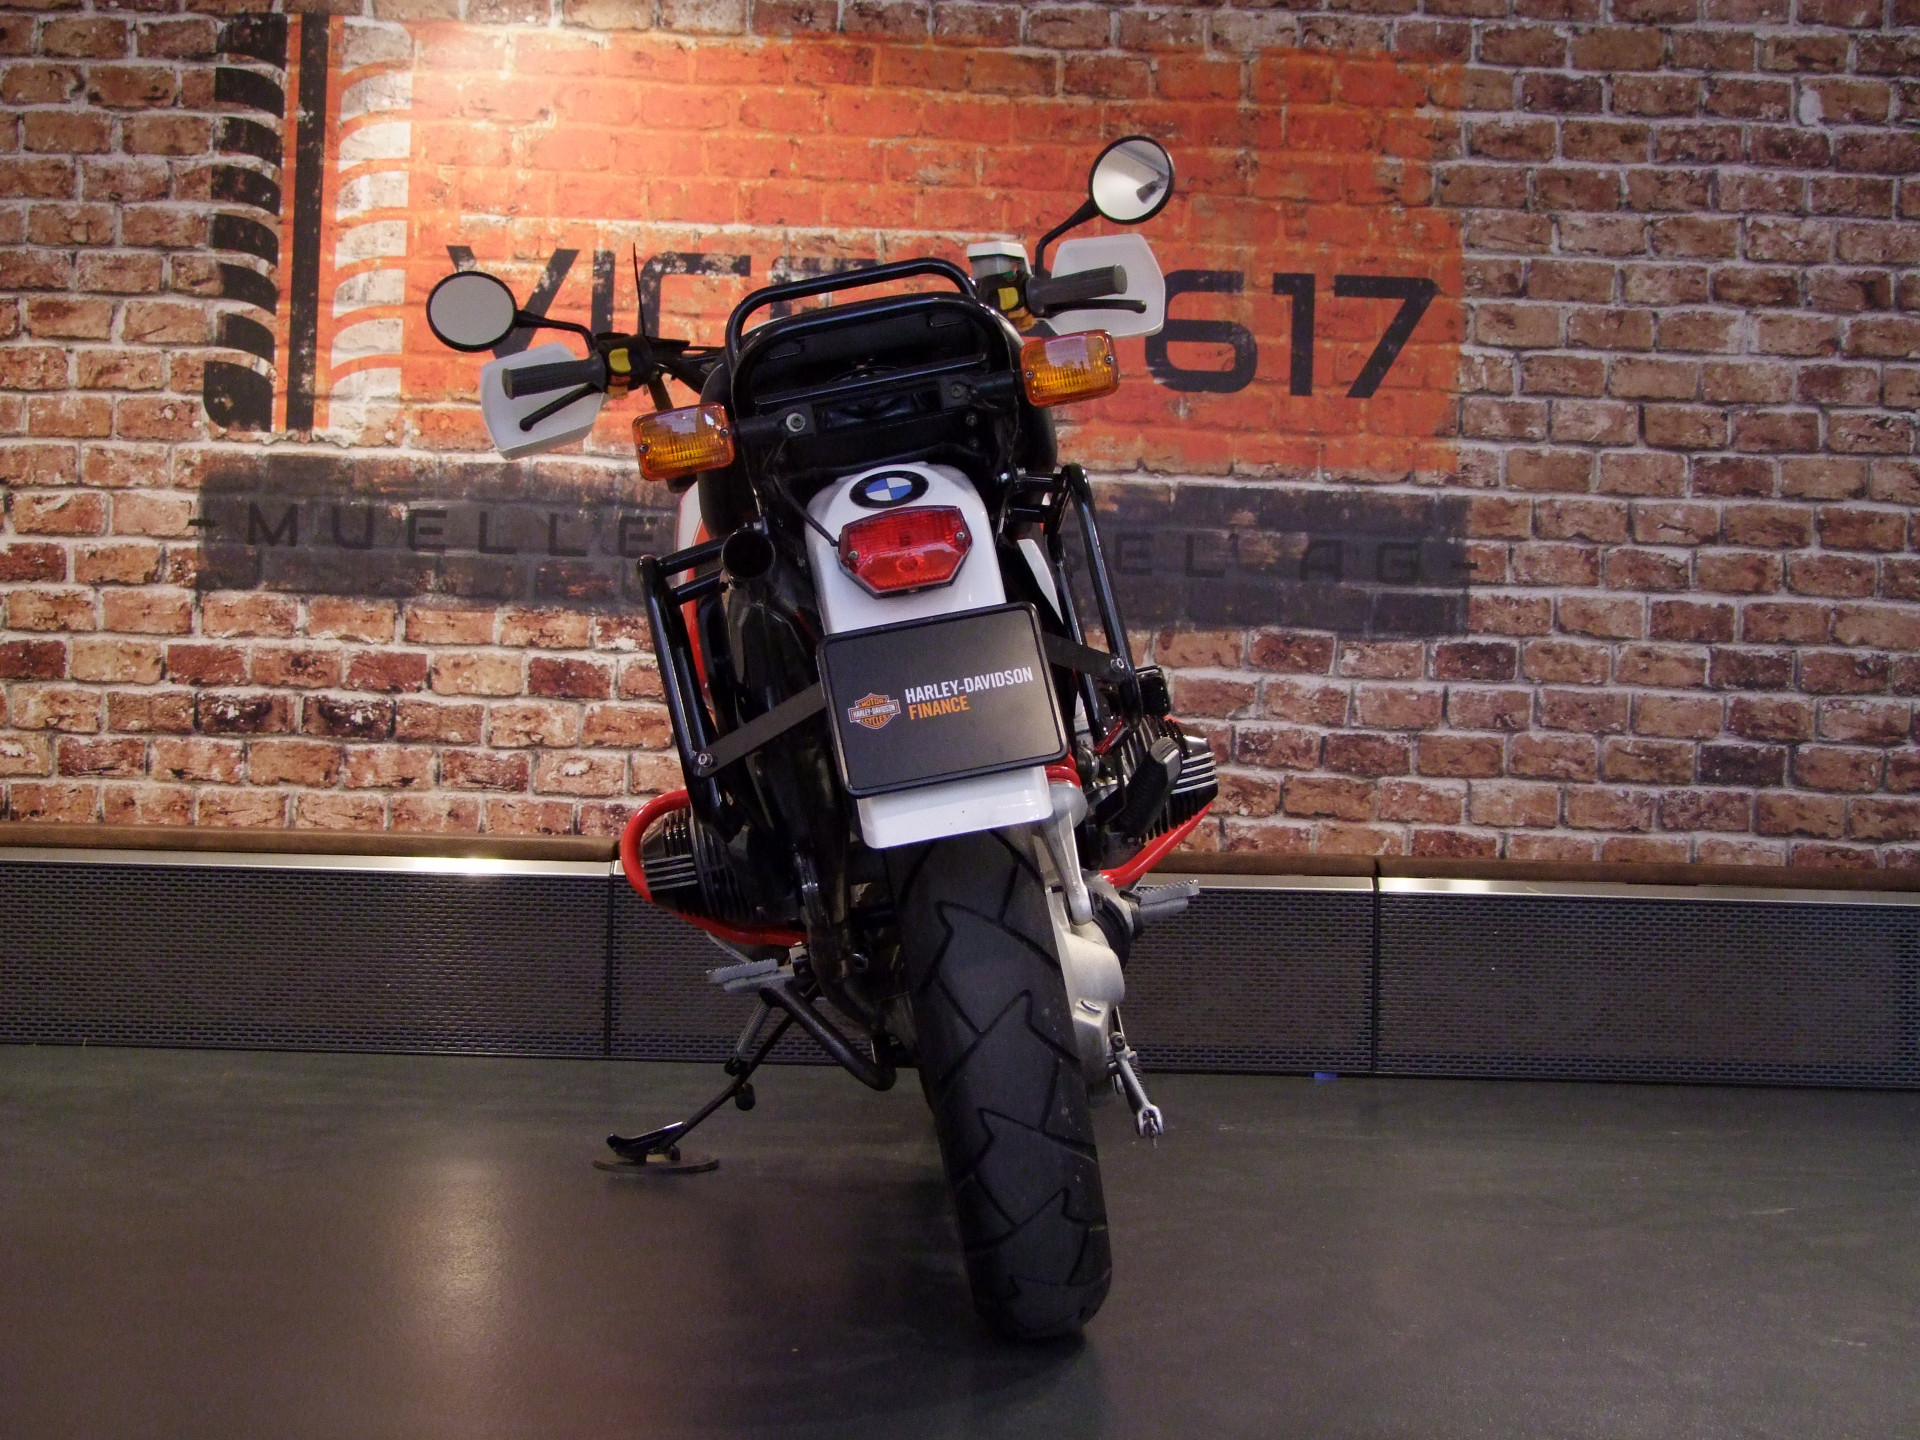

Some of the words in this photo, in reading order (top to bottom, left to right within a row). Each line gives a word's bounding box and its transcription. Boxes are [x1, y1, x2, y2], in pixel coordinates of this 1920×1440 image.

[247, 503, 660, 559] MUELLE
[904, 666, 1034, 704] HARLEY-DAVIDSON
[908, 695, 970, 720] FINANCE
